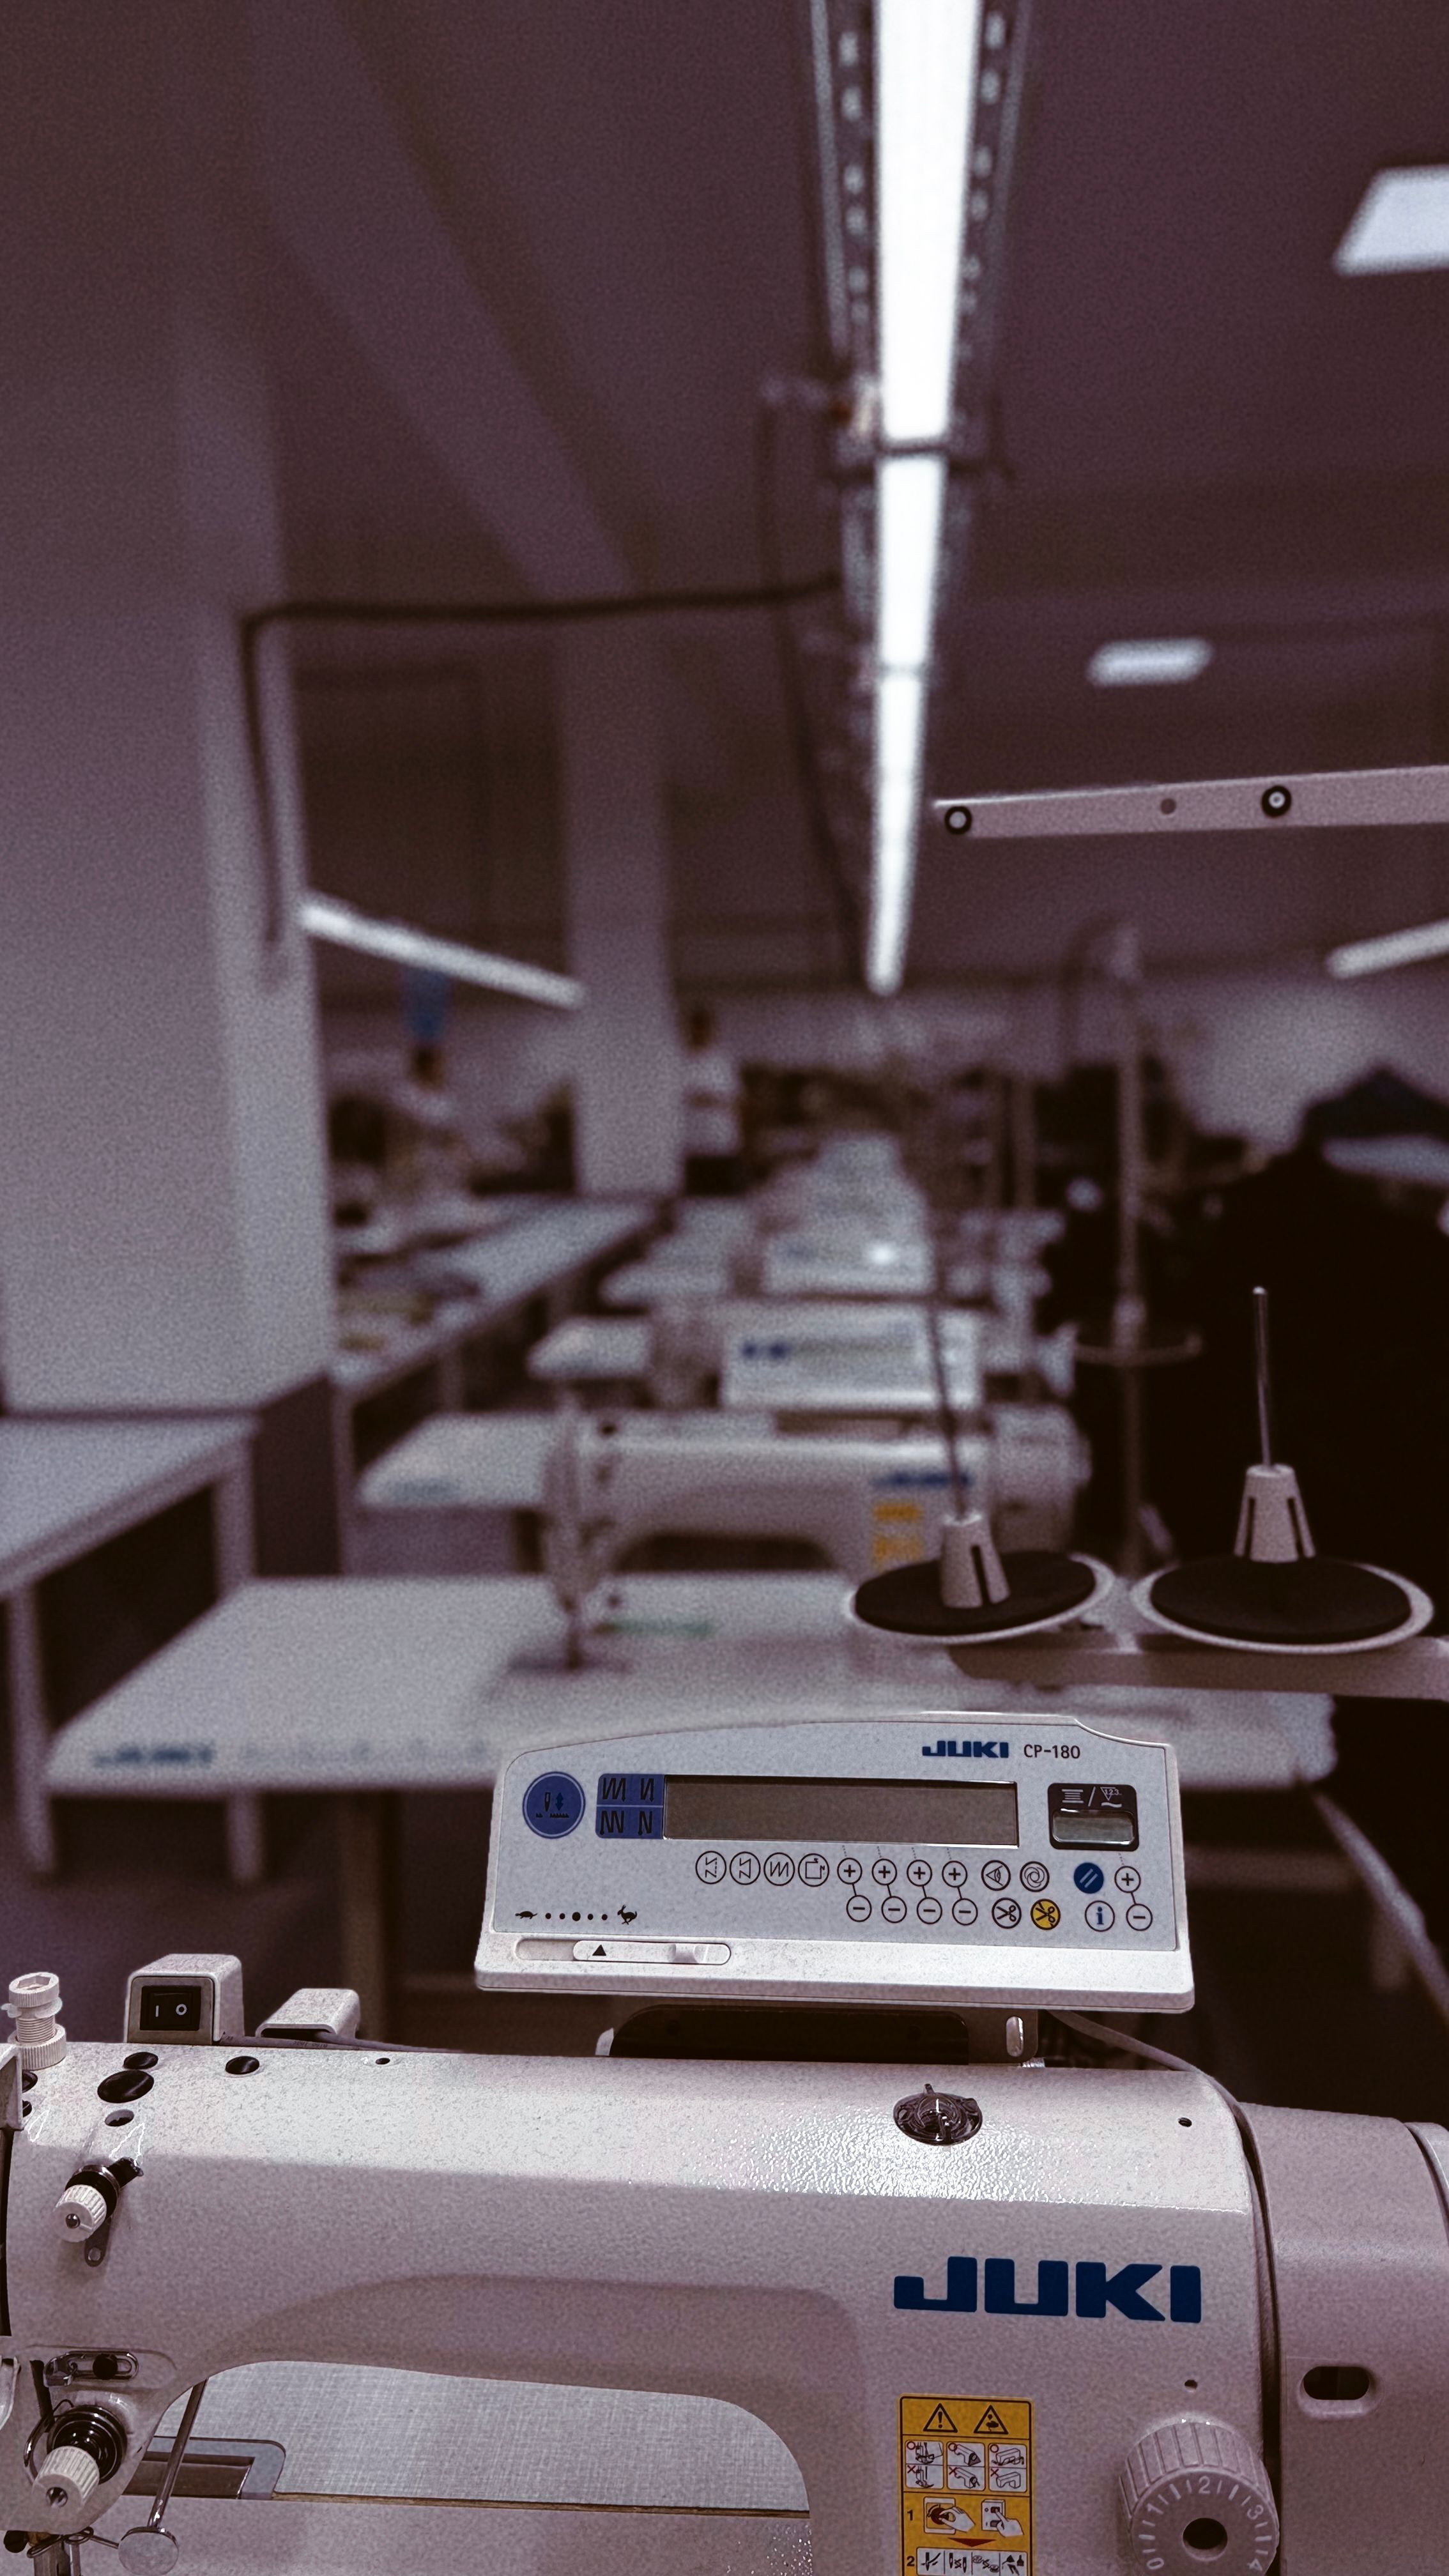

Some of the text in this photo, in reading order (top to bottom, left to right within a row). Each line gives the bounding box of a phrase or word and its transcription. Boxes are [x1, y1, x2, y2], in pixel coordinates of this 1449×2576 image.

[922, 1740, 1080, 1759] JUKI CP-180
[894, 2256, 1201, 2323] JUKI
[1199, 2476, 1211, 2494] 2
[907, 2510, 914, 2520] 1
[1147, 2503, 1163, 2515] 1
[1246, 2504, 1264, 2520] 3
[907, 2556, 916, 2567] 2
[1146, 2557, 1165, 2570] 0
[1247, 2558, 1263, 2572] 4
